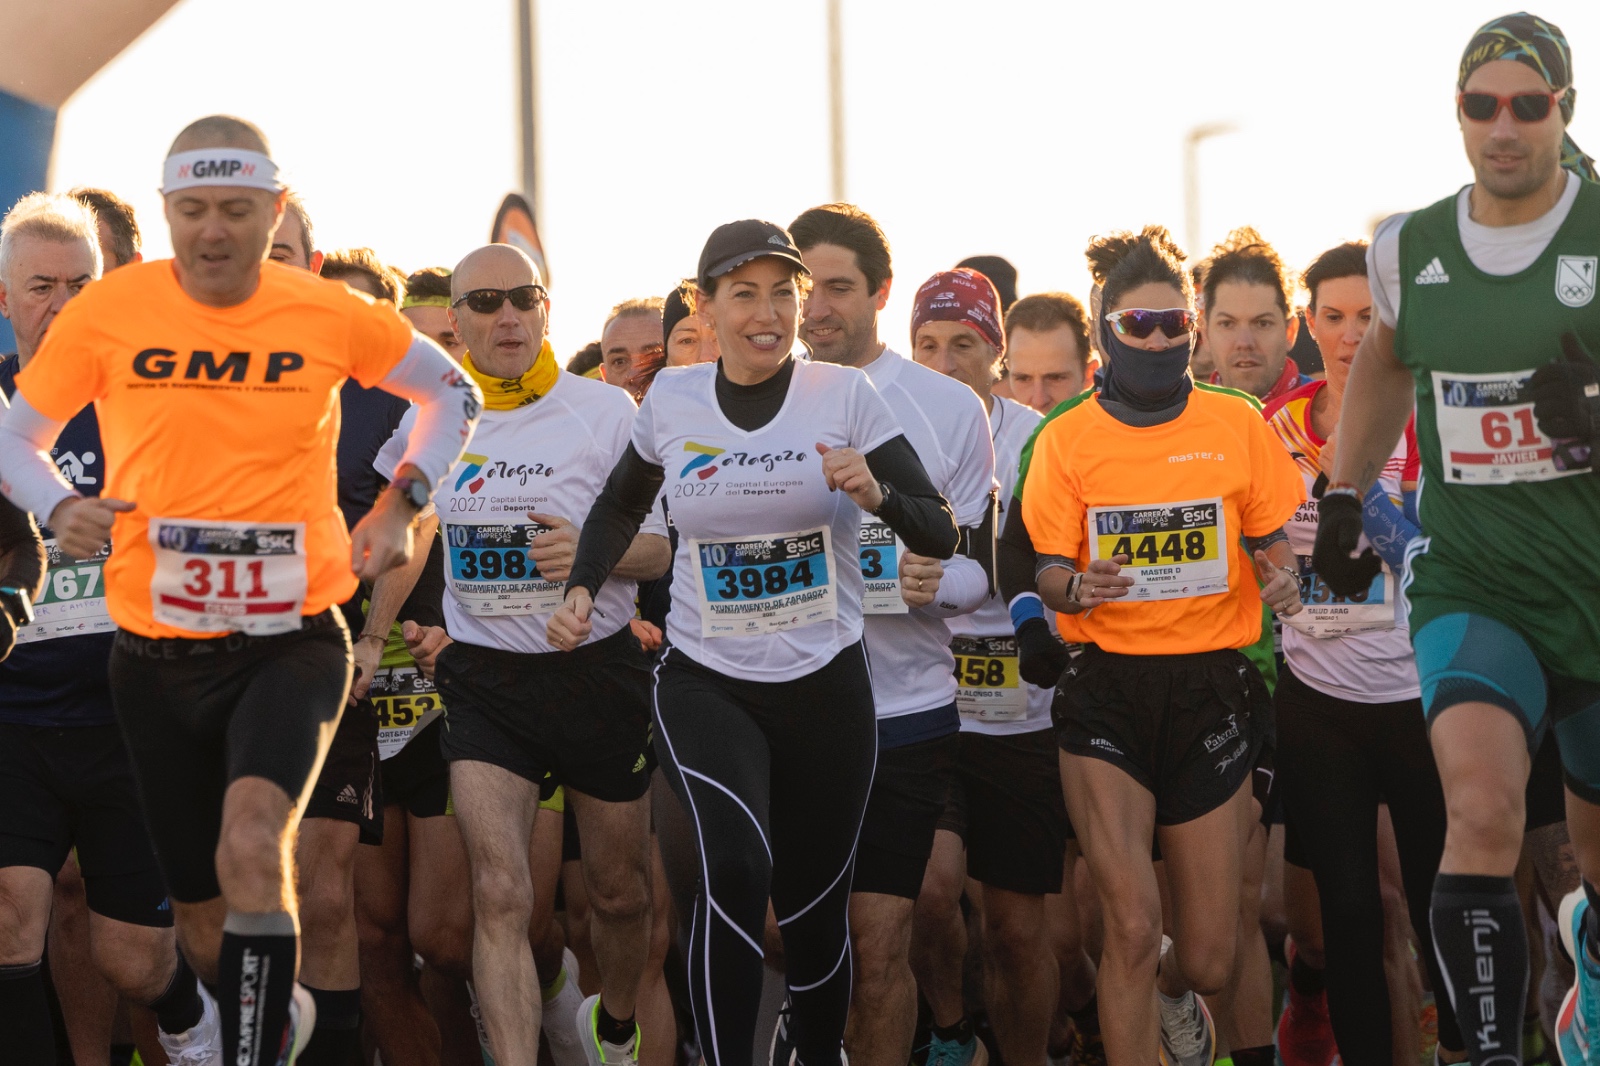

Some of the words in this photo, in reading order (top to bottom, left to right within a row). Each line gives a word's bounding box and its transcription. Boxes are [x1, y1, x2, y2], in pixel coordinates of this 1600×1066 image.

[192, 159, 242, 178] GMP
[1492, 450, 1538, 465] JAVIER
[725, 480, 761, 488] Capital
[674, 483, 719, 498] 2027
[743, 488, 786, 496] Deporte
[450, 496, 486, 512] 2027
[490, 496, 517, 504] Capital
[518, 496, 548, 504] Europea
[490, 504, 502, 512] del
[503, 504, 536, 512] Deporte
[1132, 510, 1167, 519] CARRERA
[1183, 508, 1214, 523] esic
[1132, 516, 1169, 525] EMPRESAS
[477, 526, 511, 534] CARRERA
[859, 527, 892, 540] esic
[476, 532, 512, 540] EMPRESAS
[735, 542, 769, 551] CARRERA
[786, 537, 820, 554] esic
[1112, 530, 1206, 566] 4448
[735, 548, 771, 557] EMPRESAS
[1140, 568, 1173, 576] MASTER
[184, 558, 269, 599] 311
[716, 559, 814, 600] 3984
[509, 583, 518, 591] DE
[710, 601, 771, 612] AYUNTAMIENTO
[773, 598, 783, 607] DE
[785, 588, 829, 604] ZARAGOZA
[988, 640, 1015, 651] esic
[964, 690, 993, 698] ALONSO
[1463, 908, 1501, 1052] kalenji
